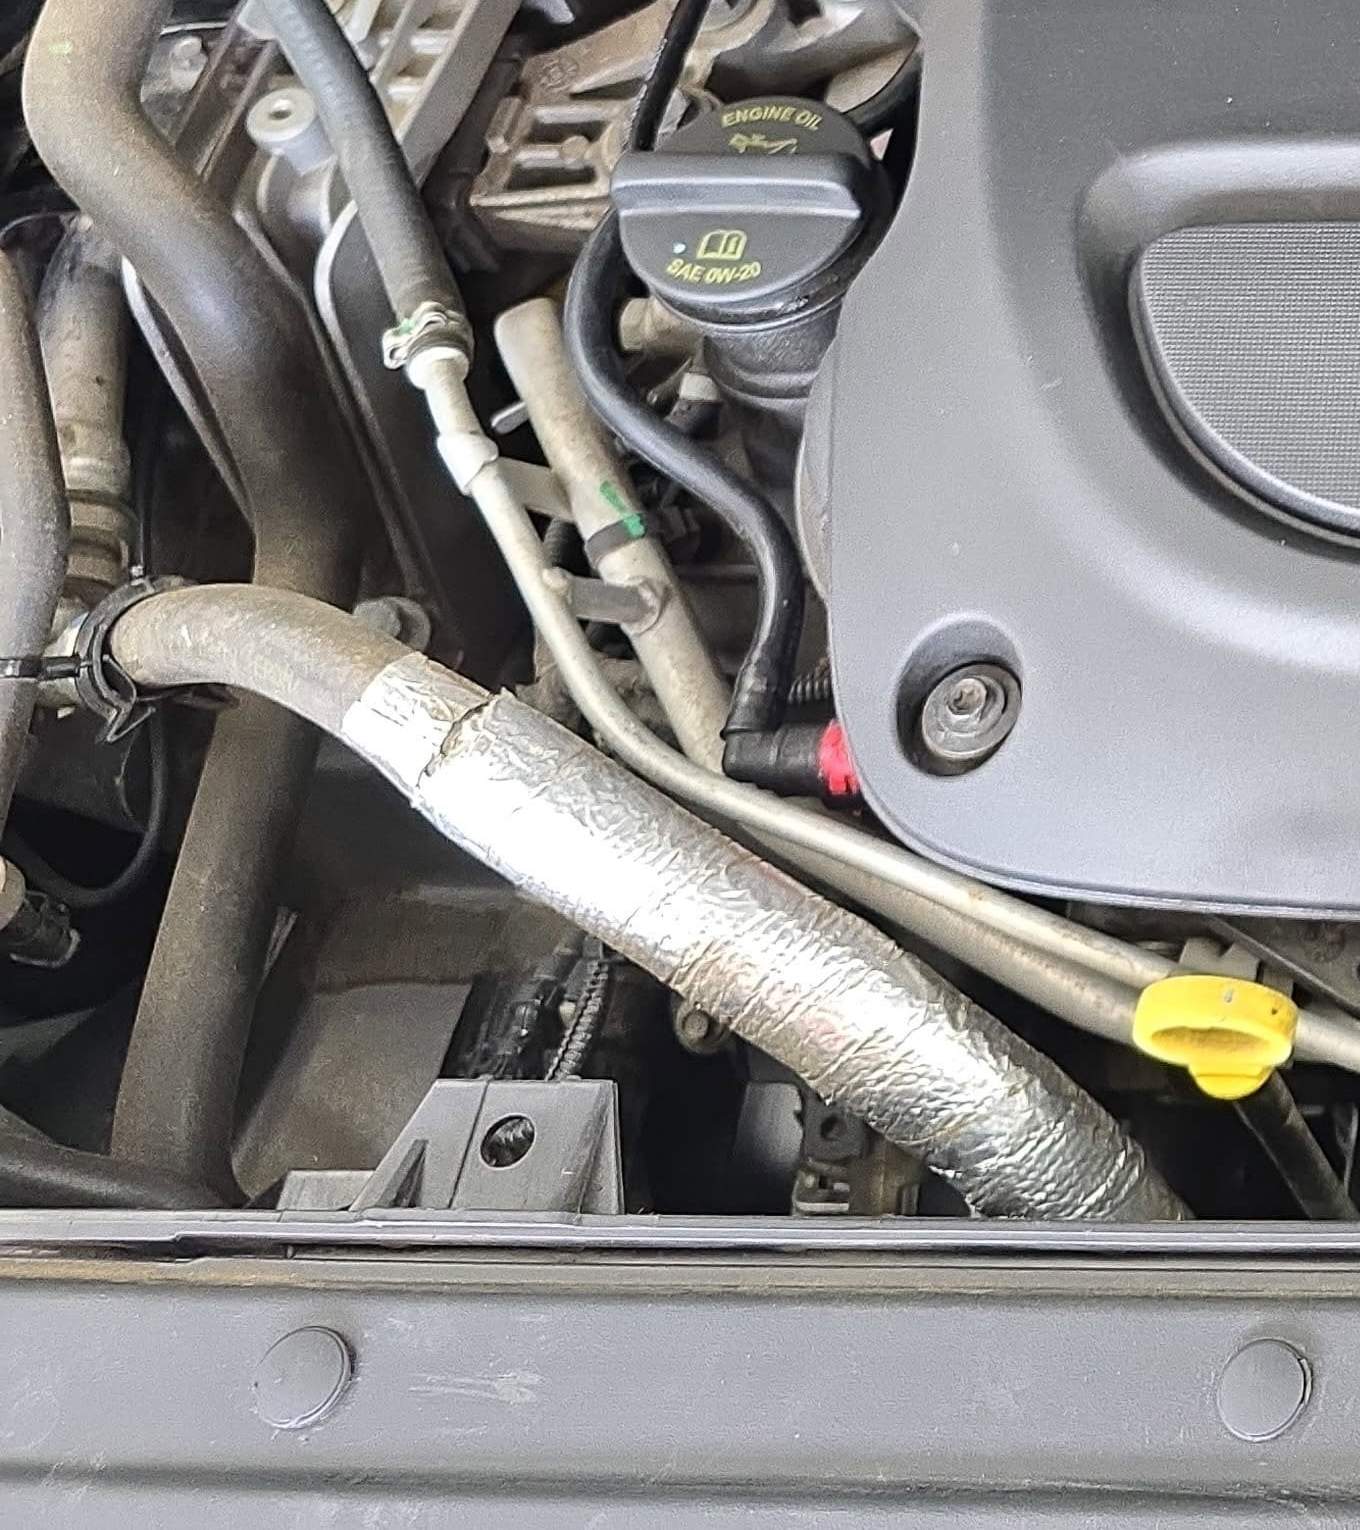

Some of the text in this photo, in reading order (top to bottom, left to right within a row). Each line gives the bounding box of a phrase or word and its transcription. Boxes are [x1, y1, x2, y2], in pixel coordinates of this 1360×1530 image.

[721, 104, 824, 131] ENGINE OIL
[666, 258, 762, 285] SAE 0W-20
